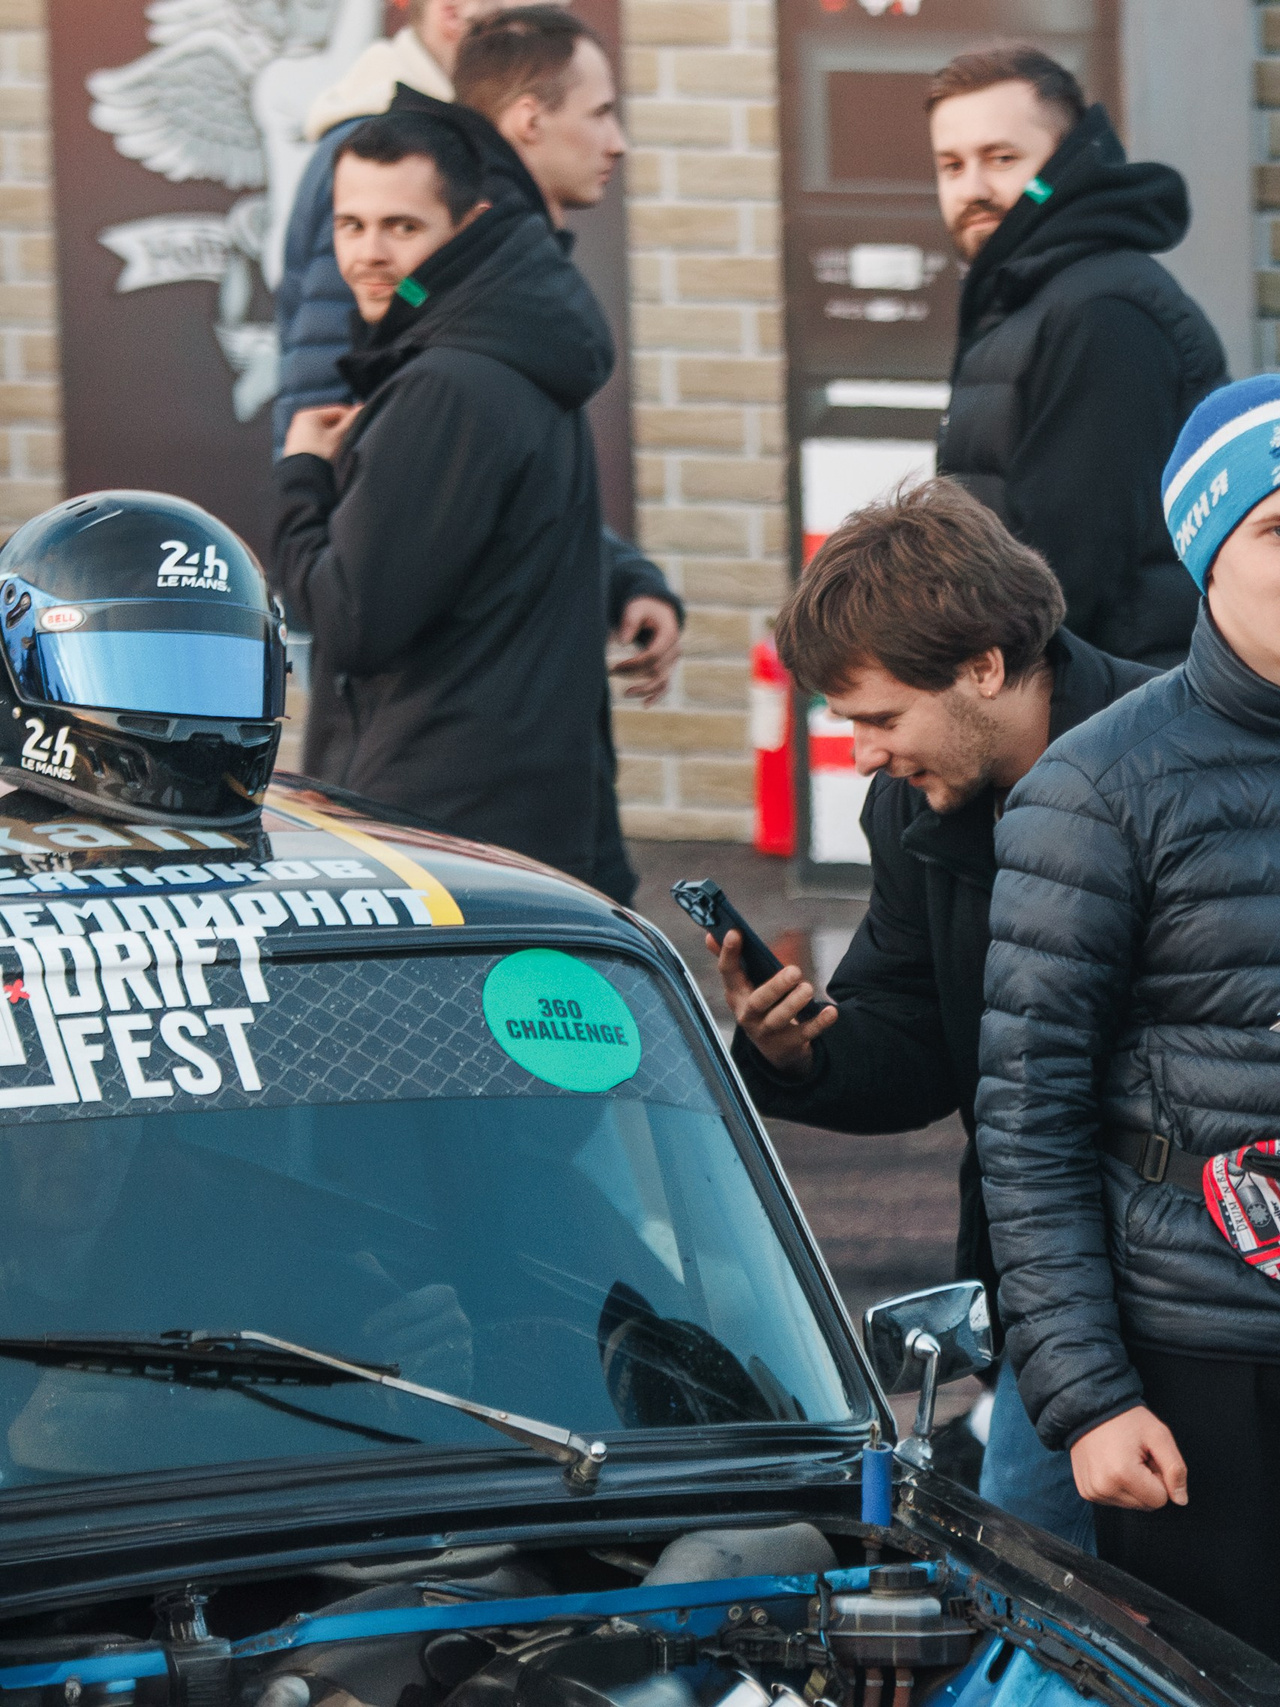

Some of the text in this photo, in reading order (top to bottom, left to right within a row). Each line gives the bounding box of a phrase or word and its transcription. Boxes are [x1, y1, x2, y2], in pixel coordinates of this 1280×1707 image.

[157, 540, 229, 580] 24h
[157, 575, 181, 588] LE
[48, 614, 75, 624] BELL
[21, 718, 76, 767] 24h
[21, 757, 36, 770] LE
[0, 888, 430, 941] ЕМПИОНАТ
[34, 926, 270, 1015] DRIFT
[537, 998, 582, 1019] 360
[505, 1019, 629, 1047] CHALLENGE
[58, 1007, 262, 1102] FEST
[1229, 1201, 1248, 1233] DRUM
